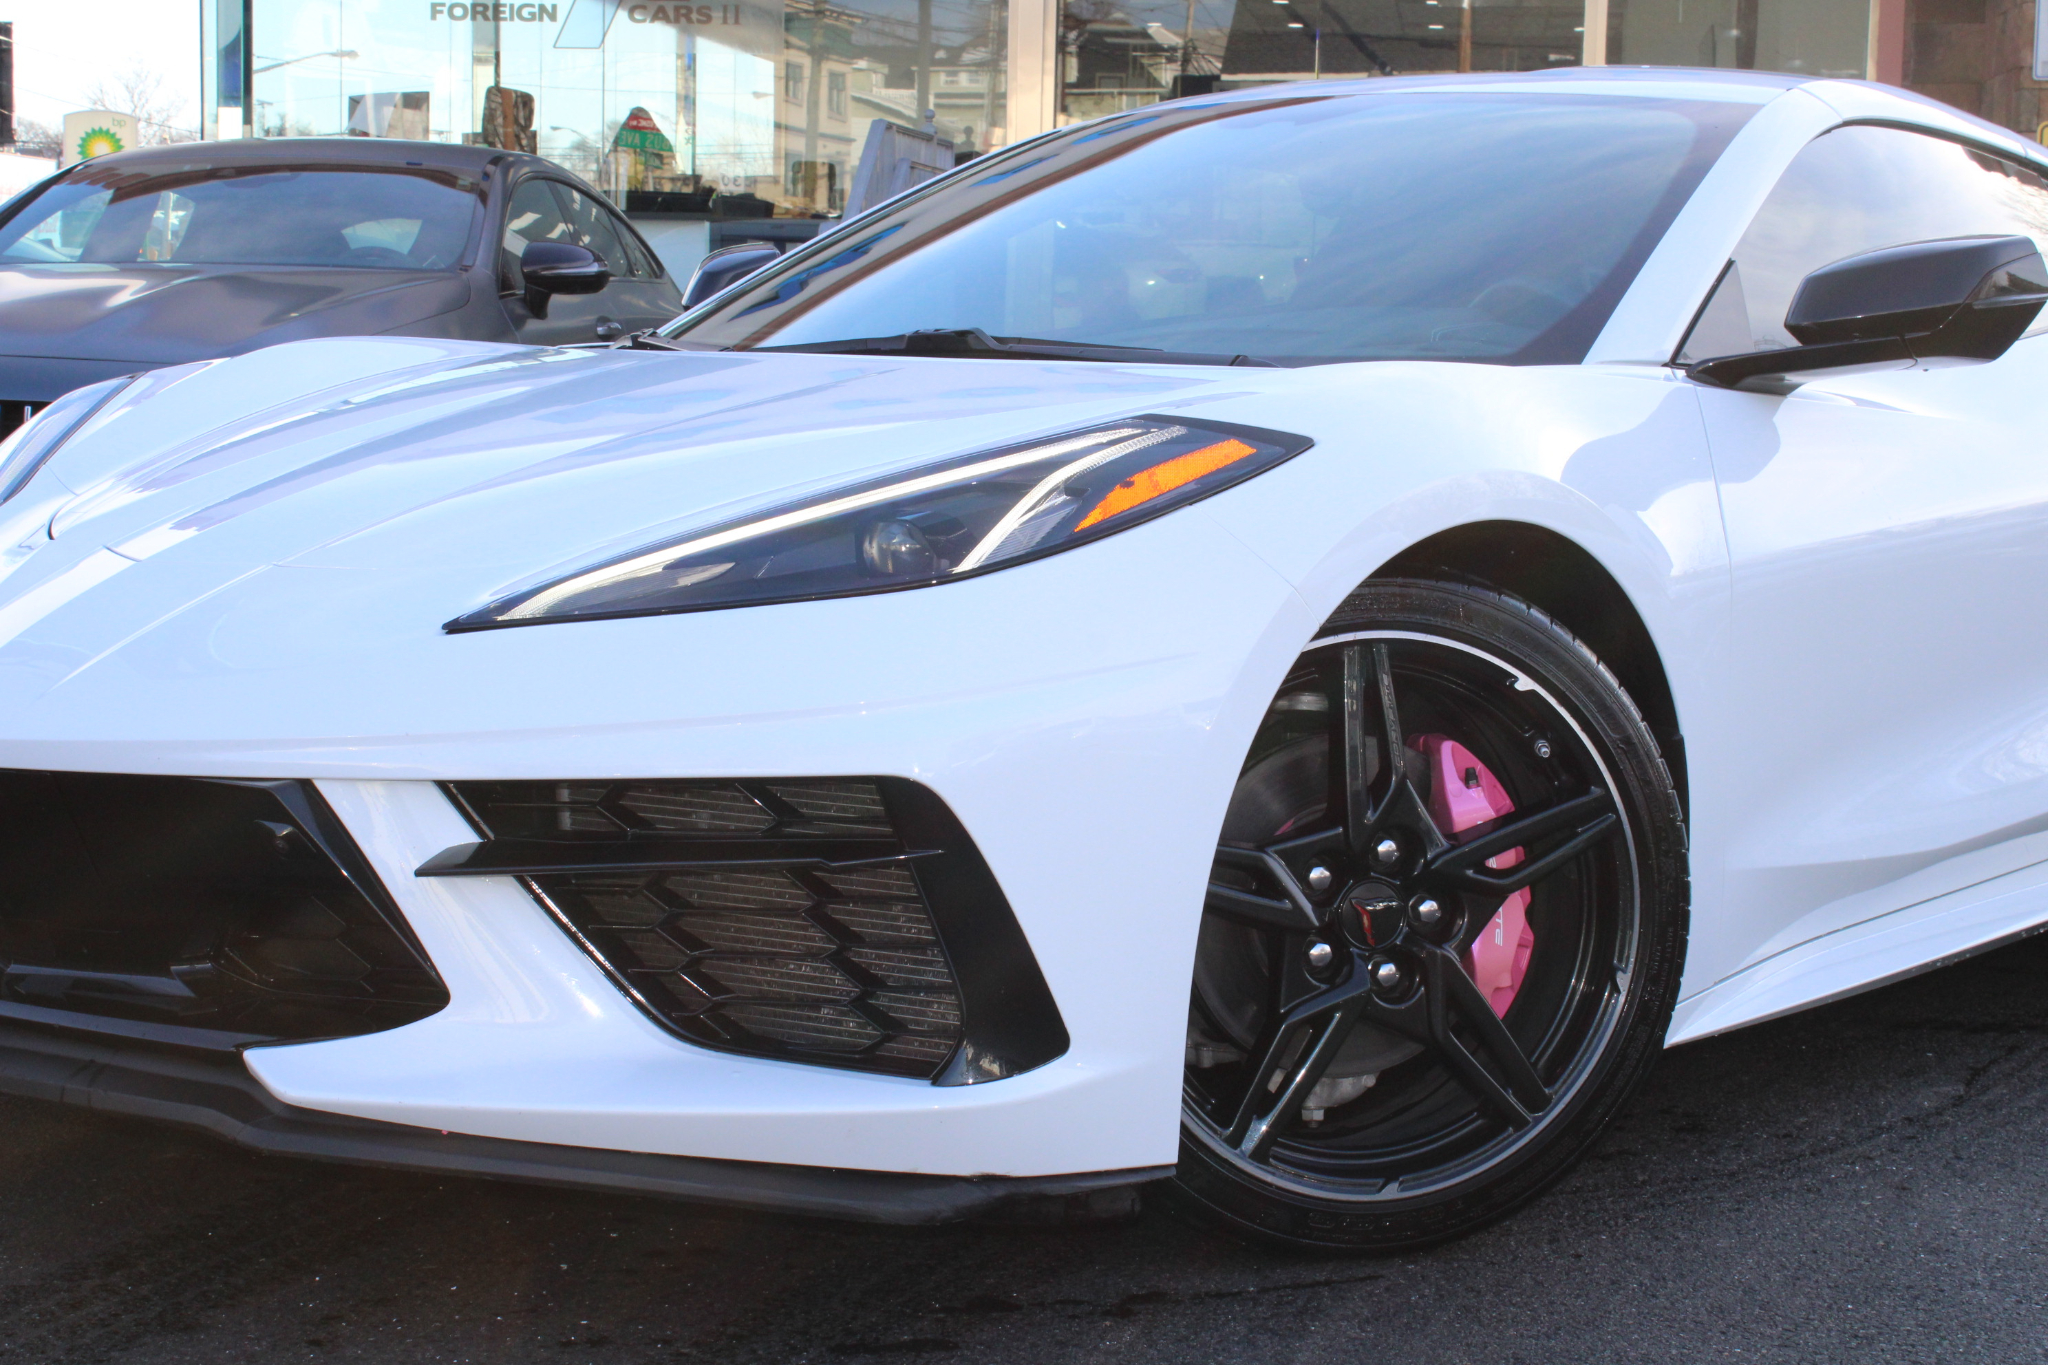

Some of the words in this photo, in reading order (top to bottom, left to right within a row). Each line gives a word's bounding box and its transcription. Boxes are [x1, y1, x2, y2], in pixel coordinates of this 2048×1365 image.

[430, 2, 557, 22] FOREIGN
[628, 4, 713, 25] CARS
[721, 5, 741, 25] II
[112, 117, 126, 128] bp
